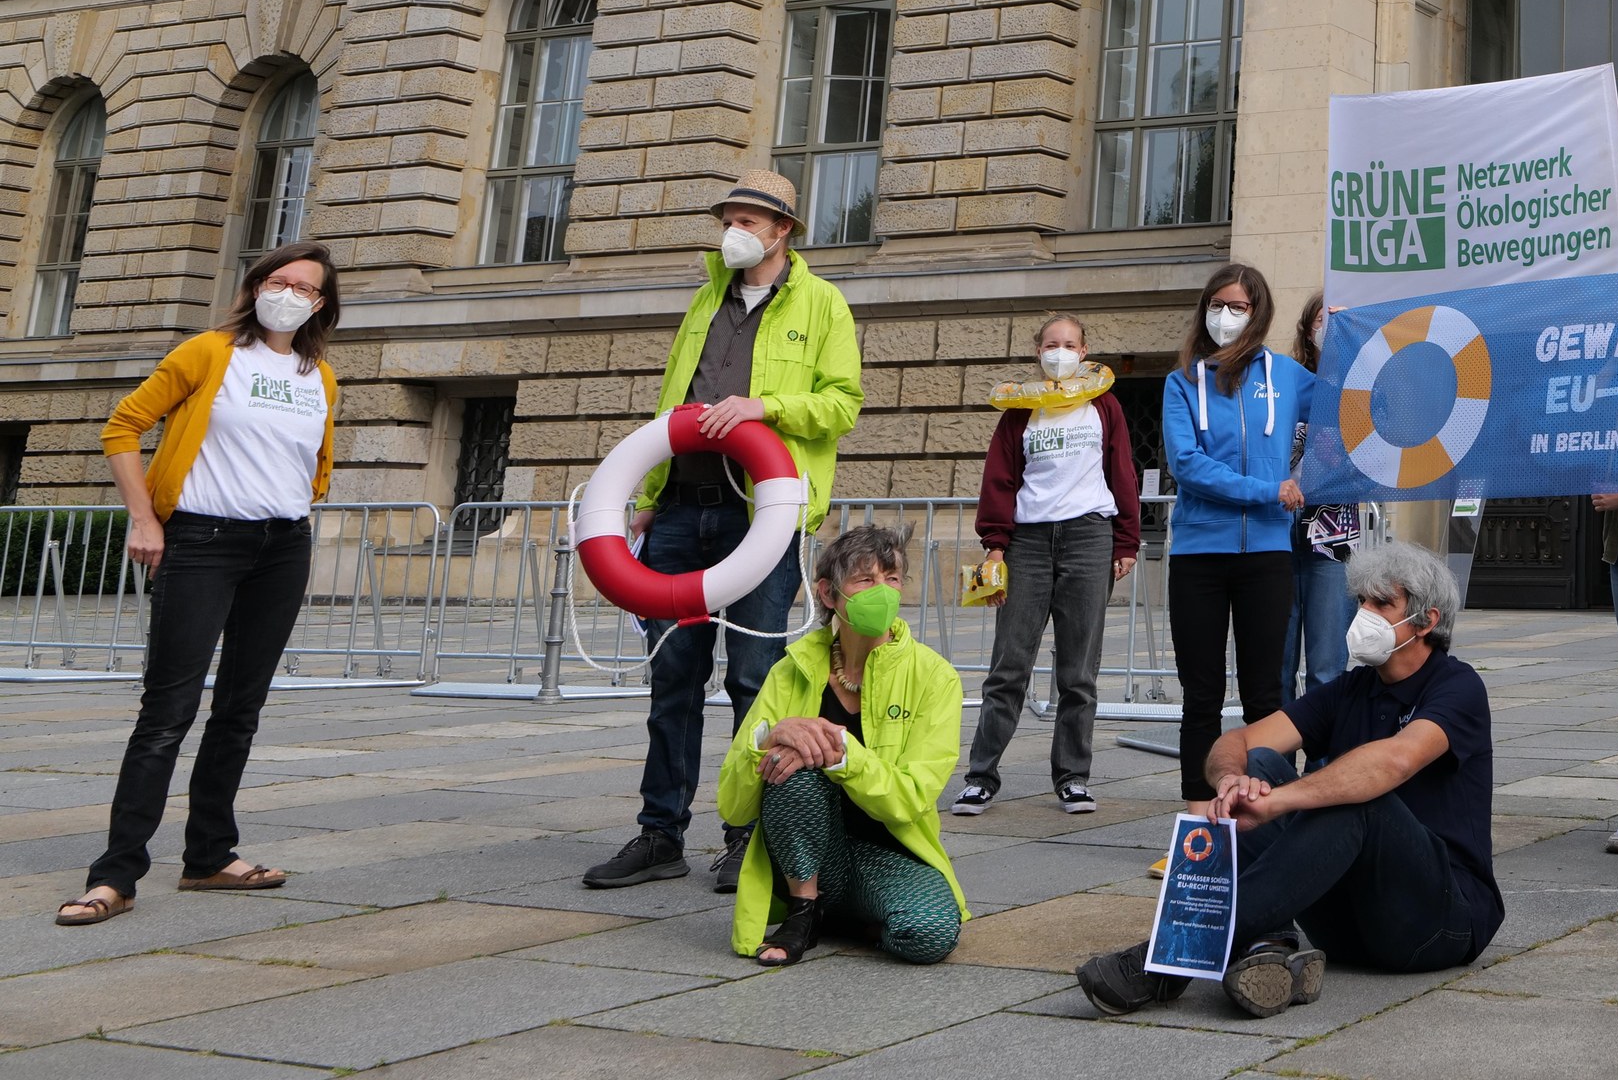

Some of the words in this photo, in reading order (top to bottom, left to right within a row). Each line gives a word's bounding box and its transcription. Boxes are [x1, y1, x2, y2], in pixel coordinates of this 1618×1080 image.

[1457, 147, 1573, 191] Netzwerk
[1331, 160, 1446, 218] GRÜNE
[1456, 184, 1612, 230] Ökologischer
[1344, 219, 1428, 266] LIGA
[1457, 226, 1612, 268] Bewegungen
[258, 385, 289, 402] LIGA
[248, 401, 296, 413] Landesverband
[297, 408, 313, 417] Berlin
[1029, 427, 1064, 441] GRÜNE
[1530, 433, 1548, 454] IN
[1034, 439, 1059, 452] LIGA
[1177, 873, 1210, 883] GEWÄSSER
[1177, 881, 1208, 890] EU-RECHT
